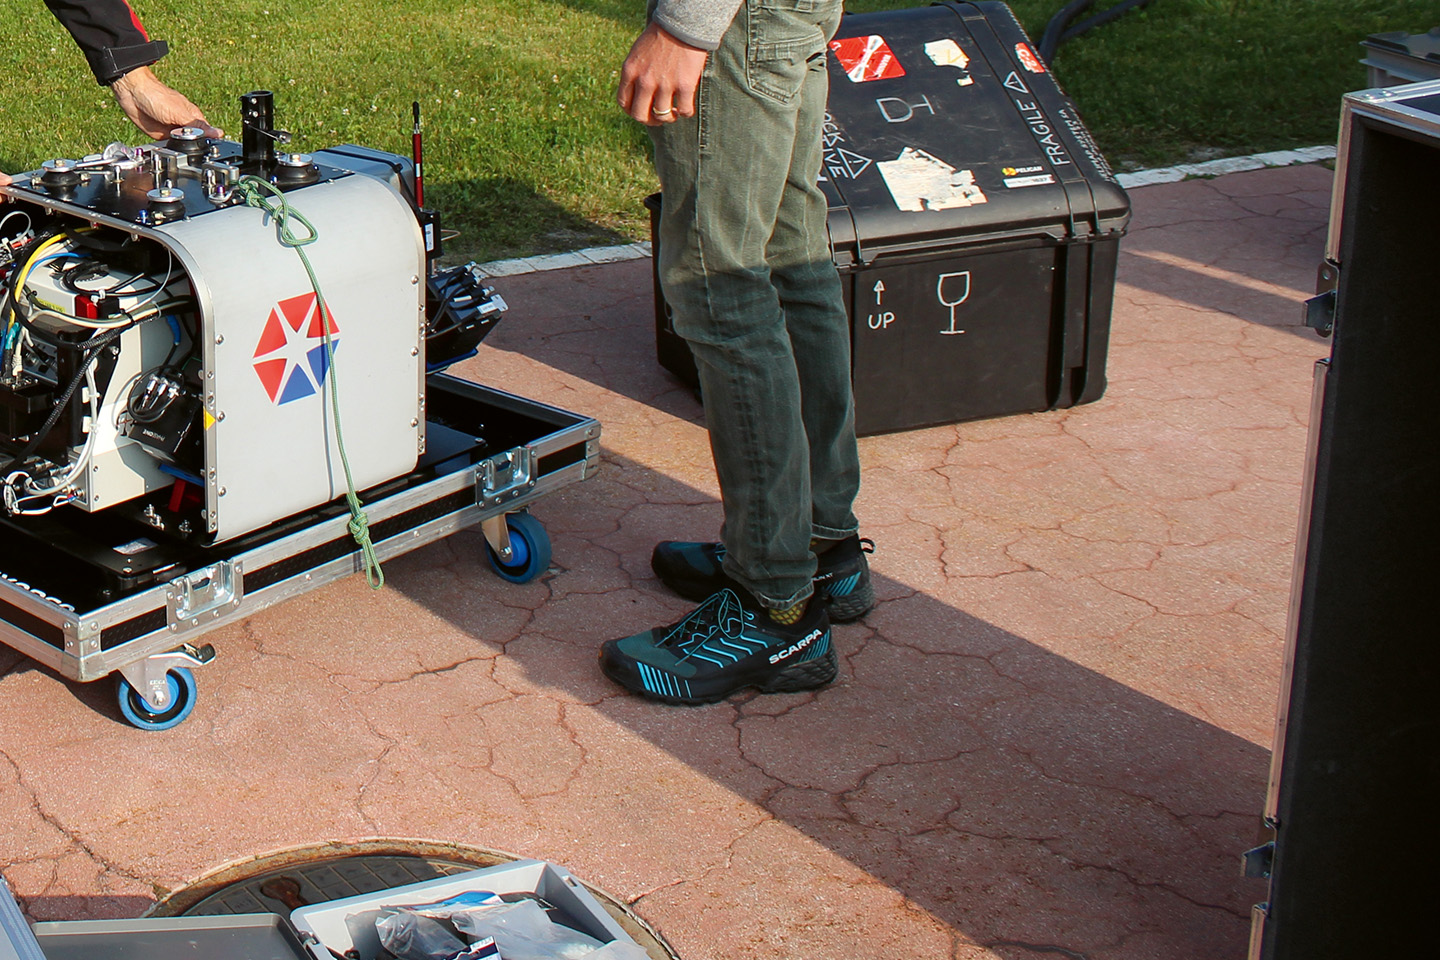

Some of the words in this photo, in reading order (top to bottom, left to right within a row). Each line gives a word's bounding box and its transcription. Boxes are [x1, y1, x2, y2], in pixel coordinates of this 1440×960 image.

[1016, 98, 1071, 166] FRAGILE
[1015, 165, 1044, 174] PELICAN
[868, 311, 896, 330] UP
[768, 628, 823, 664] SCARPA
